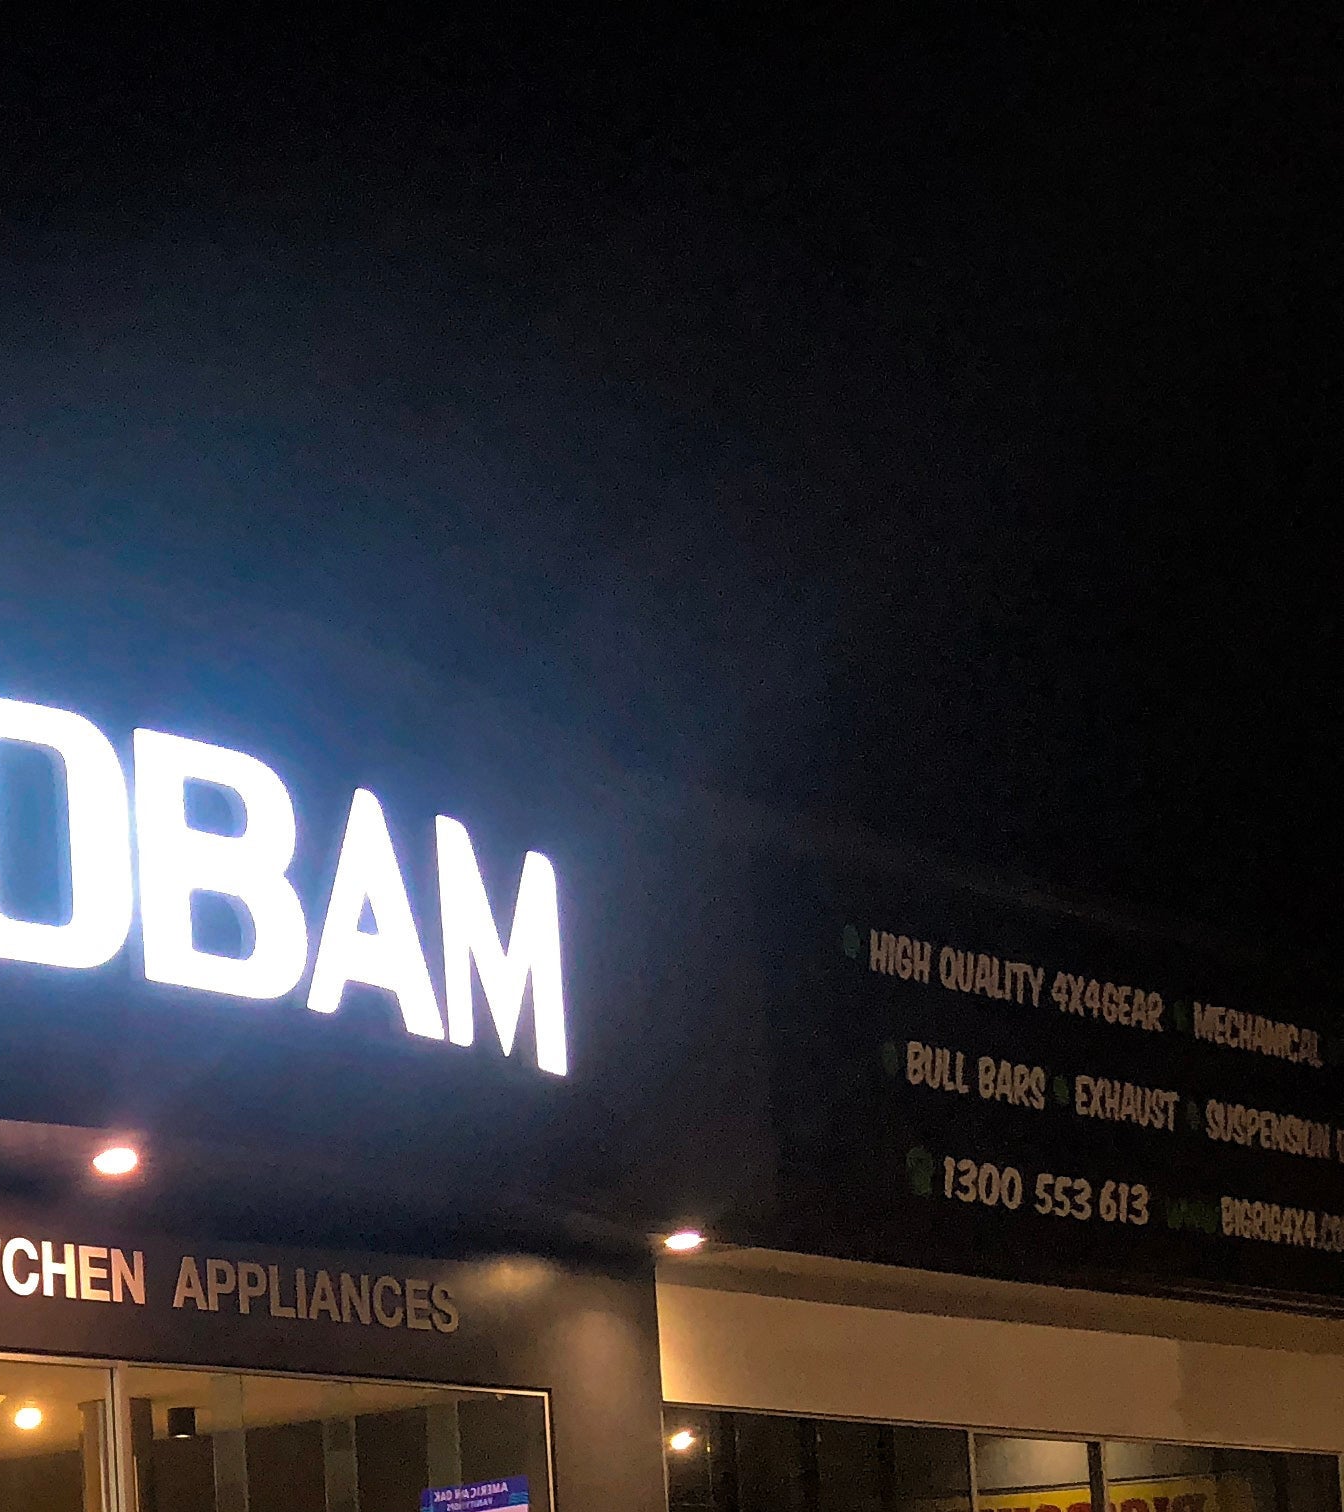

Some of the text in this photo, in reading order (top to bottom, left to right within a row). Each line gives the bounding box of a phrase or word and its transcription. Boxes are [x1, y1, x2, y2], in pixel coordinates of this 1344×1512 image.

[869, 928, 931, 984] HIGH
[939, 946, 1044, 1007] QUALITY
[905, 1040, 969, 1095] BULL
[978, 1054, 1046, 1111] BARS
[1074, 1075, 1180, 1132] EXHAUST
[1205, 1099, 1330, 1159] SUSPENSION
[943, 1155, 1023, 1211] 1300
[1035, 1173, 1092, 1221] 553
[1098, 1180, 1151, 1226] 613
[173, 1256, 459, 1334] APPLIANCES
